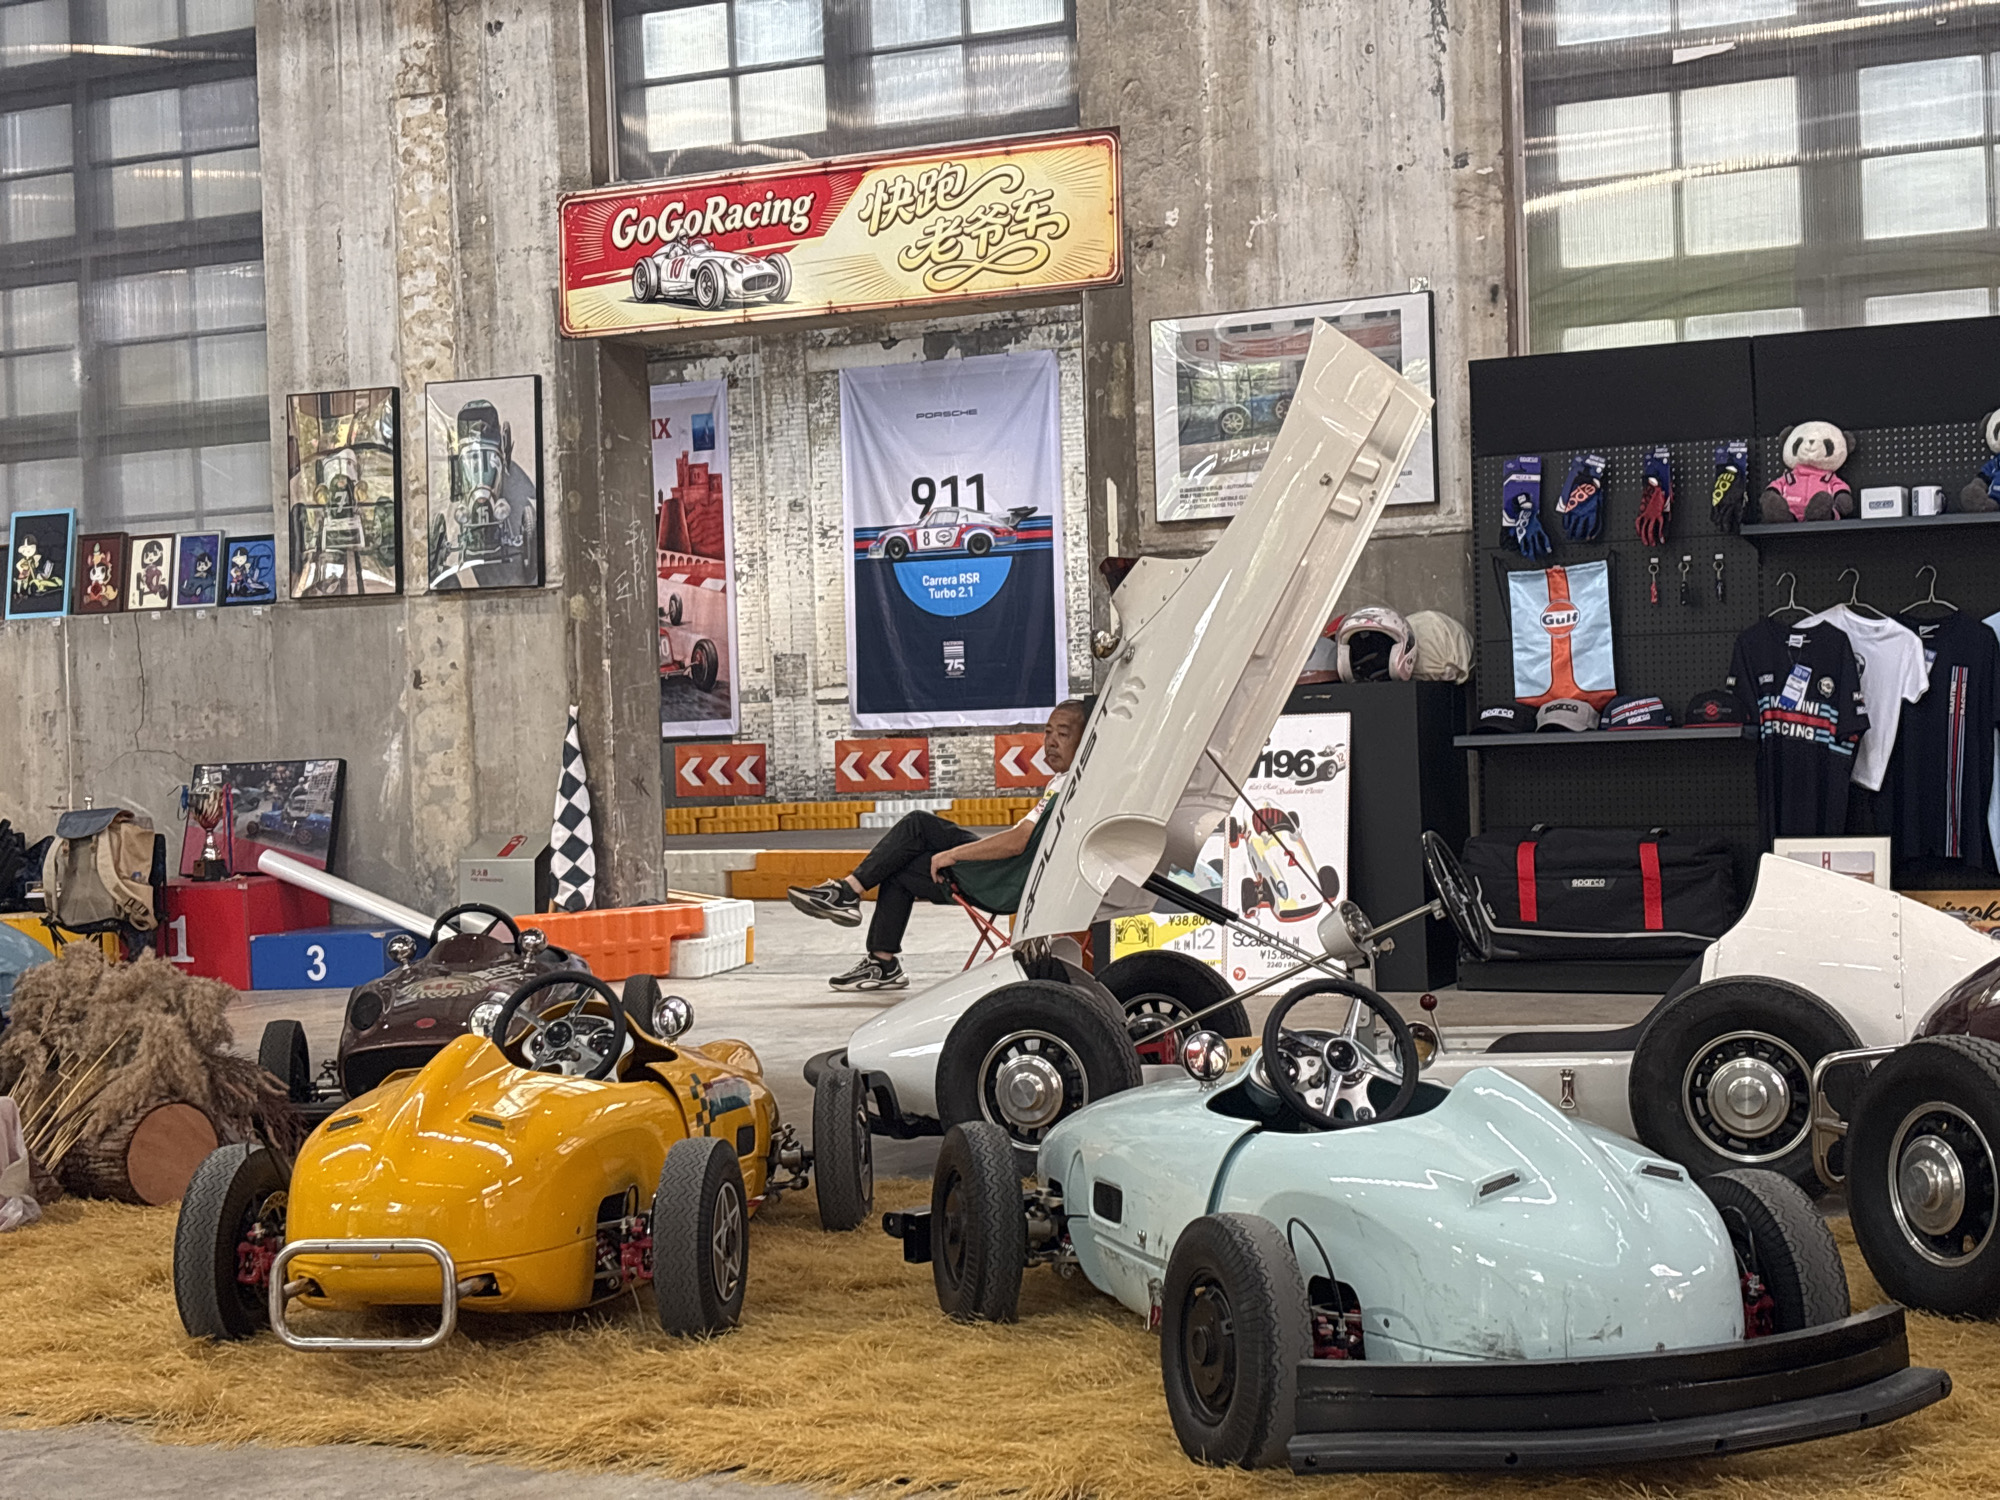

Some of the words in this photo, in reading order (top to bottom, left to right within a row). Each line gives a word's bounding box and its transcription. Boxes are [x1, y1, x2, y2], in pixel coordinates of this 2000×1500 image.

[858, 162, 1025, 237] 快跑
[612, 190, 815, 250] GoGoRacing
[898, 188, 1070, 292] 老爷车
[669, 257, 685, 280] 10
[915, 408, 978, 420] PORSCHE
[911, 473, 985, 519] 911
[476, 506, 489, 524] 15
[923, 531, 931, 546] 8
[922, 575, 957, 586] Carrera
[959, 572, 980, 584] RSR
[929, 587, 956, 599] Turbo
[958, 585, 973, 598] 2.1
[1542, 612, 1578, 626] Gulf
[1572, 879, 1605, 887] sparco
[169, 915, 195, 963] 1
[1190, 928, 1215, 950] 1:2
[306, 944, 327, 981] 3
